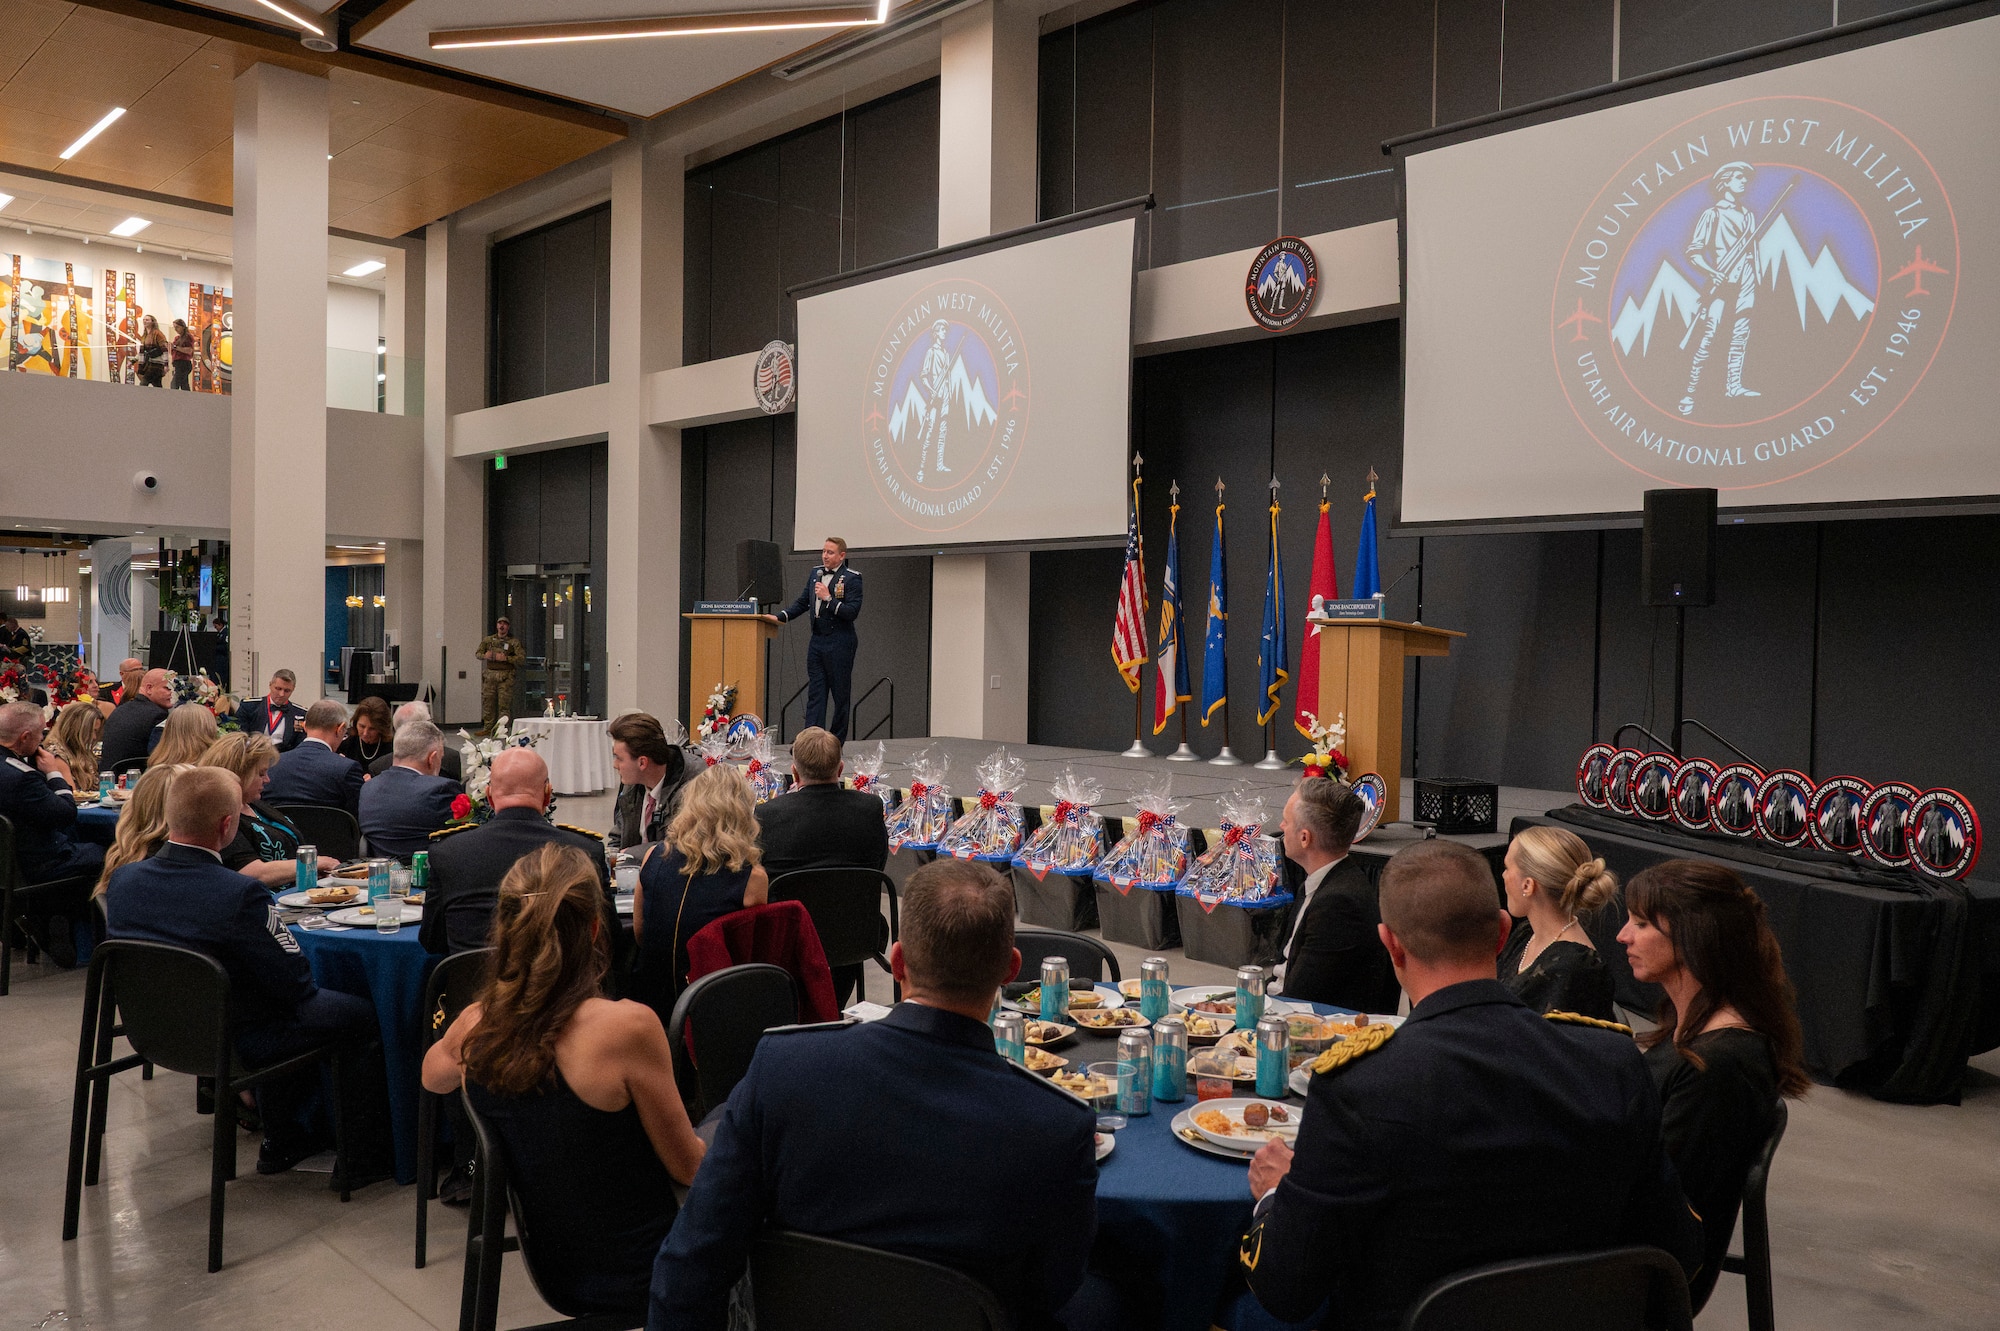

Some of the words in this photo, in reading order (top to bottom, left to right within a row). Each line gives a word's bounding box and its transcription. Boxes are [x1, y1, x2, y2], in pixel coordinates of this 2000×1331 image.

[1575, 135, 1709, 289] MOUNTAIN
[1726, 117, 1820, 149] WEST
[1825, 128, 1929, 240] MILITIA
[1250, 243, 1280, 281] MOUNTAIN
[1281, 241, 1298, 250] WEST
[1298, 245, 1315, 273] MILITIA
[873, 300, 931, 397] MOUNTAIN
[937, 292, 976, 312] WEST
[977, 303, 1019, 375] MILITIA
[1577, 350, 1612, 406] UTAH
[1603, 405, 1635, 438] AIR
[1635, 427, 1747, 467] NATIONAL
[1754, 414, 1835, 463] GUARD
[1850, 366, 1896, 407] EST.
[1885, 307, 1922, 359] 1946
[873, 438, 888, 475] UTAH
[885, 475, 900, 496] AIR
[898, 491, 946, 516] NATIONAL
[948, 485, 982, 515] GUARD
[986, 454, 1006, 481] EST.
[1000, 419, 1016, 450] 1946
[1631, 756, 1655, 781] MOUNTAIN
[1655, 755, 1671, 765] WEST
[1672, 761, 1695, 787] MOUNTAIN
[1695, 761, 1711, 771] WEST
[1711, 767, 1736, 794] MOUNTAIN
[1736, 767, 1753, 777] WEST
[1757, 773, 1783, 802] MOUNTAIN
[1783, 773, 1801, 784] WEST
[1810, 780, 1840, 810] MOUNTAIN
[1841, 780, 1862, 791] WEST
[1862, 786, 1890, 817] MOUNTAIN
[1891, 785, 1911, 797] WEST
[1908, 793, 1936, 825] MOUNTAIN
[1936, 792, 1957, 804] WEST
[1954, 801, 1973, 833] MILITIA
